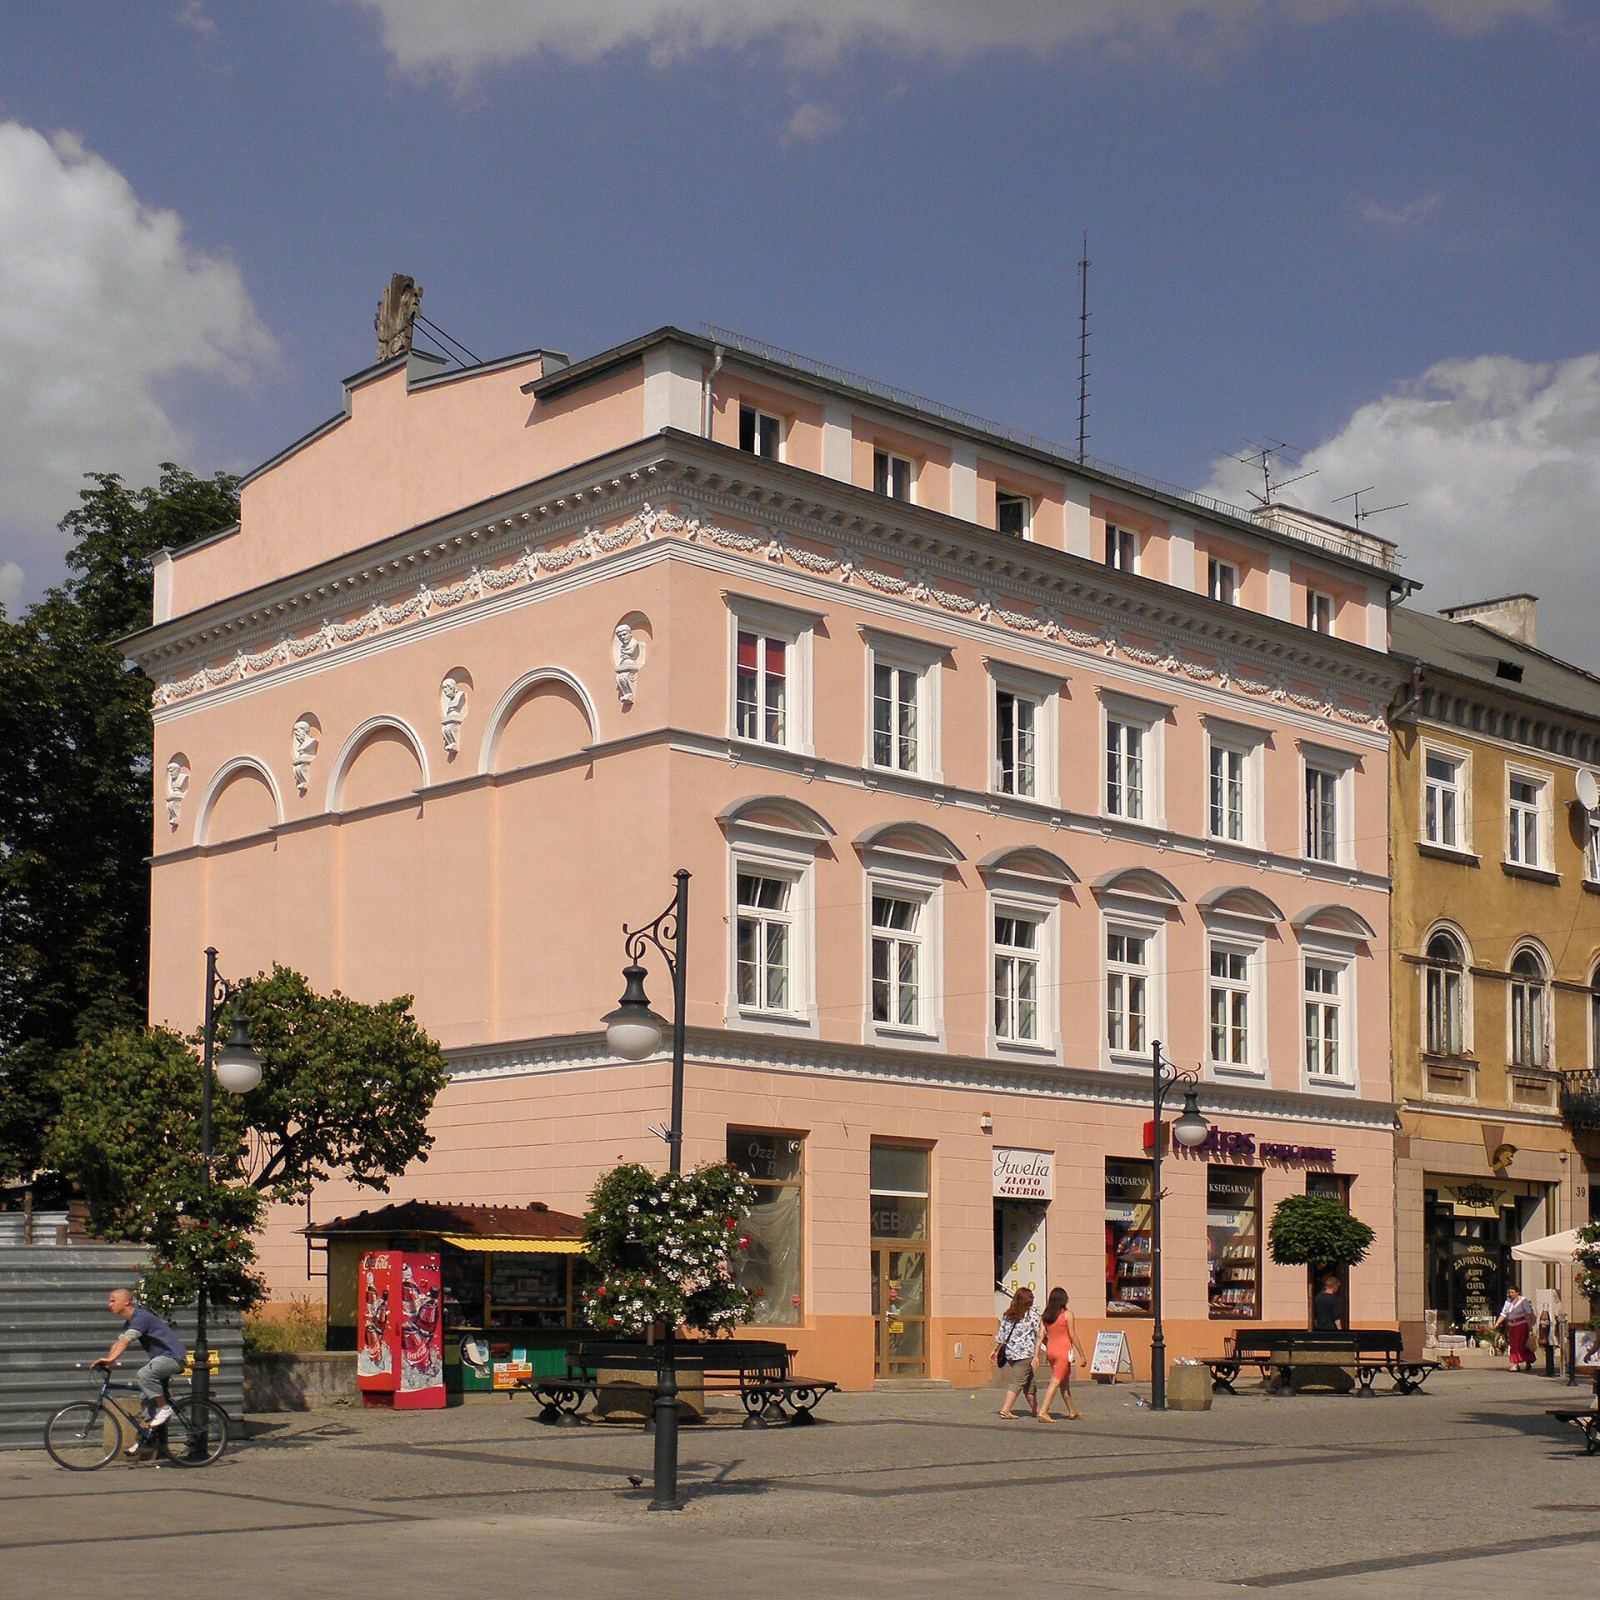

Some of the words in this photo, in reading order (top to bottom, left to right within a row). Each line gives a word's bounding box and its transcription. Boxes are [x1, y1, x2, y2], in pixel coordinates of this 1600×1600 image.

[994, 1150, 1050, 1177] Juvelia
[1004, 1176, 1041, 1186] ZŁOTO
[998, 1186, 1045, 1197] SREBRO
[1209, 1183, 1252, 1195] KSIĘGARNIA
[1575, 1186, 1585, 1198] 39
